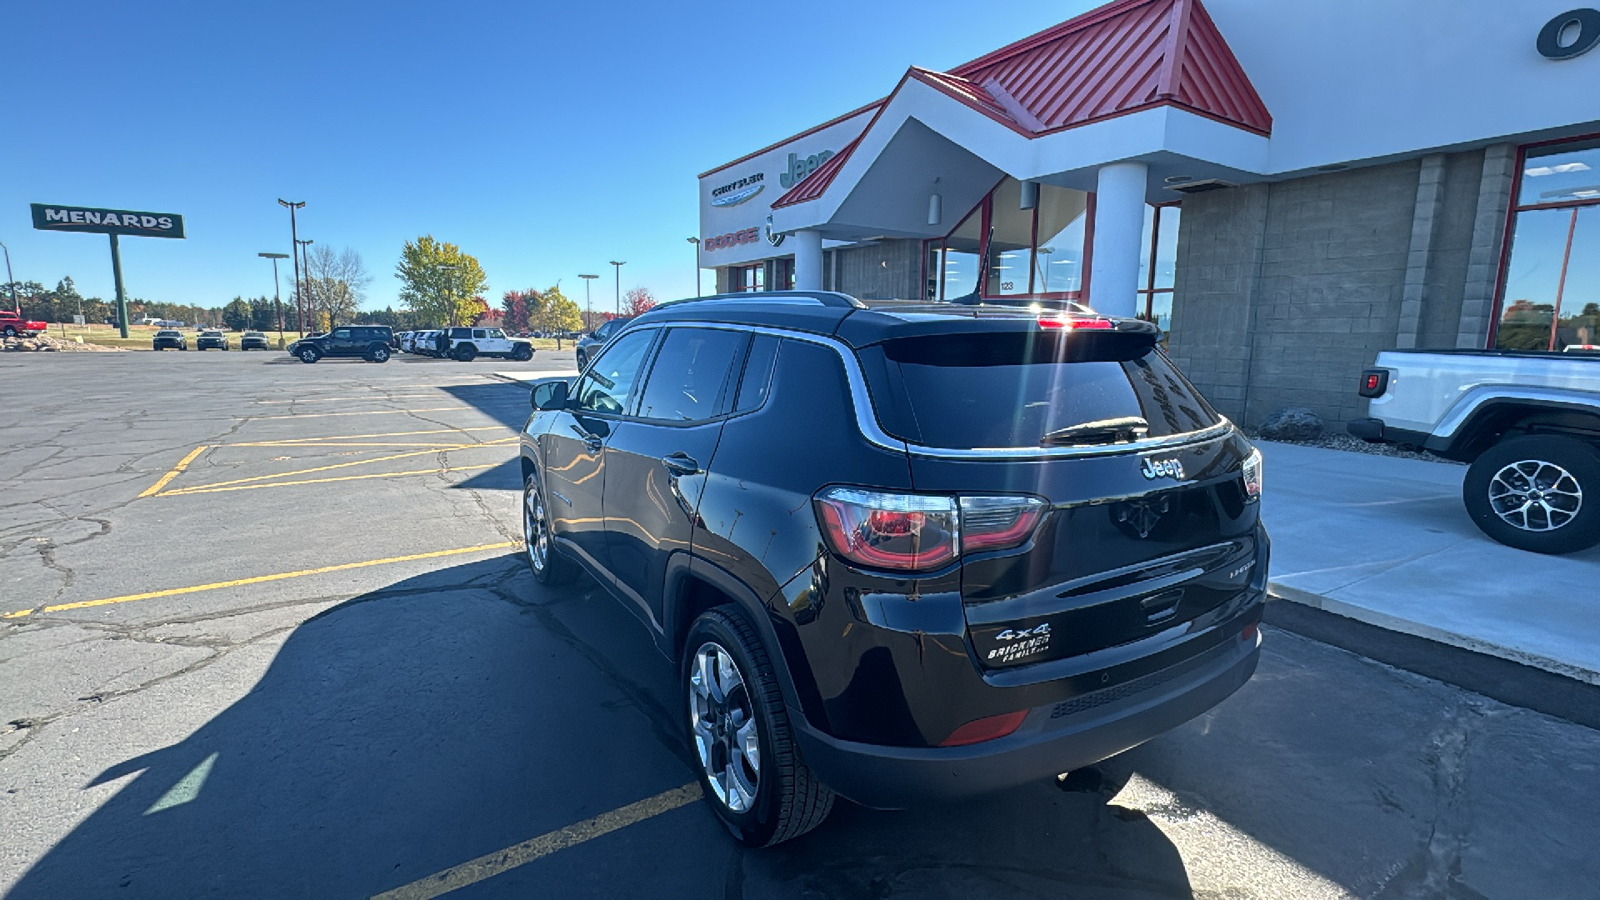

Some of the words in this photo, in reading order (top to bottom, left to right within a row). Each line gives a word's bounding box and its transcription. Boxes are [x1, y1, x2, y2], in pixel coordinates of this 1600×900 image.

[44, 208, 173, 229] MENARDS
[704, 226, 760, 251] DODGE
[1001, 282, 1014, 291] 123
[1142, 457, 1185, 479] Jeep
[987, 634, 1051, 659] BRICKNER
